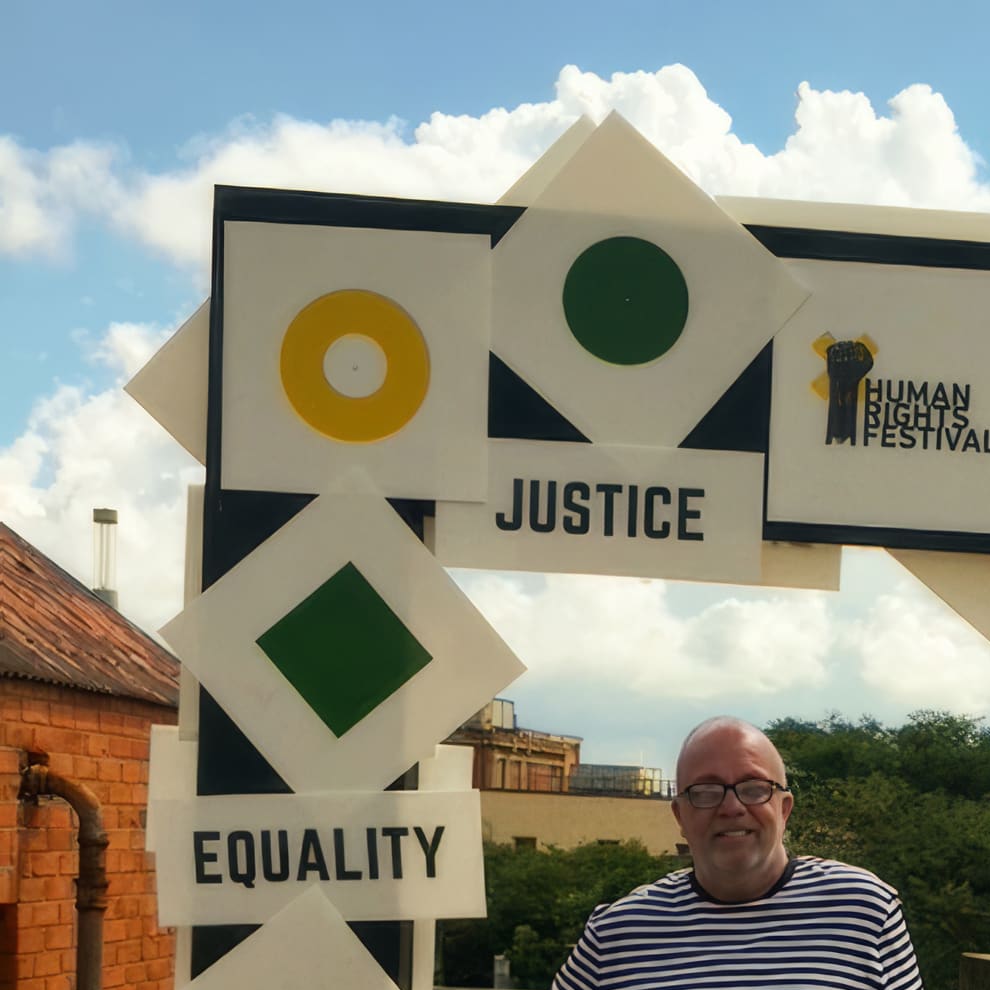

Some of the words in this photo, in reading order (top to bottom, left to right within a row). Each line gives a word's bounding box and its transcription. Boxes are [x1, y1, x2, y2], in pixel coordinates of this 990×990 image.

[864, 401, 969, 431] RIGHTS
[866, 378, 970, 411] HUMAN
[496, 479, 704, 541] JUSTICE
[194, 827, 444, 888] EQUALITY
